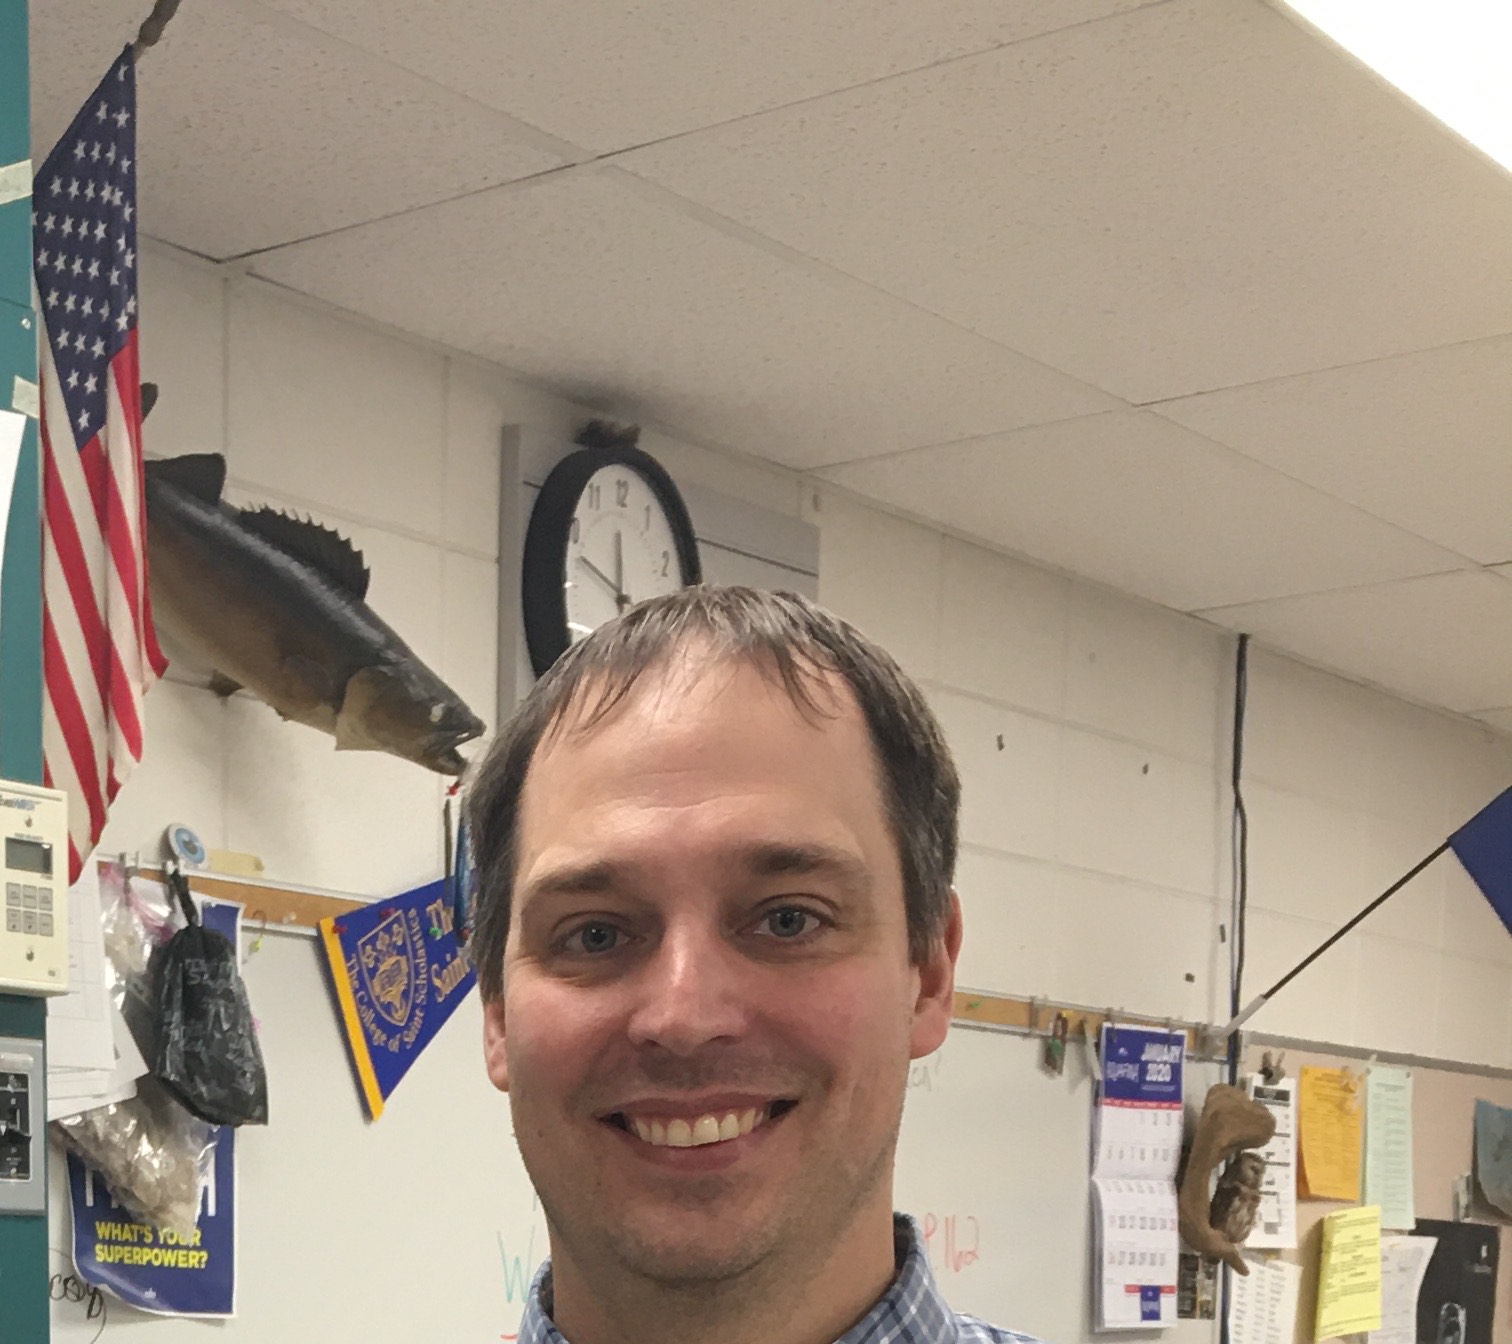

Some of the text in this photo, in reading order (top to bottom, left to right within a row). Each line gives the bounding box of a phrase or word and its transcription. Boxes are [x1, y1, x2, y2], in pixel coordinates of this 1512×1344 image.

[588, 482, 601, 512] 11
[616, 478, 630, 509] 12
[660, 549, 671, 578] 2
[95, 1220, 153, 1243] WHAT'S
[94, 1244, 209, 1269] SUPERPOWER?
